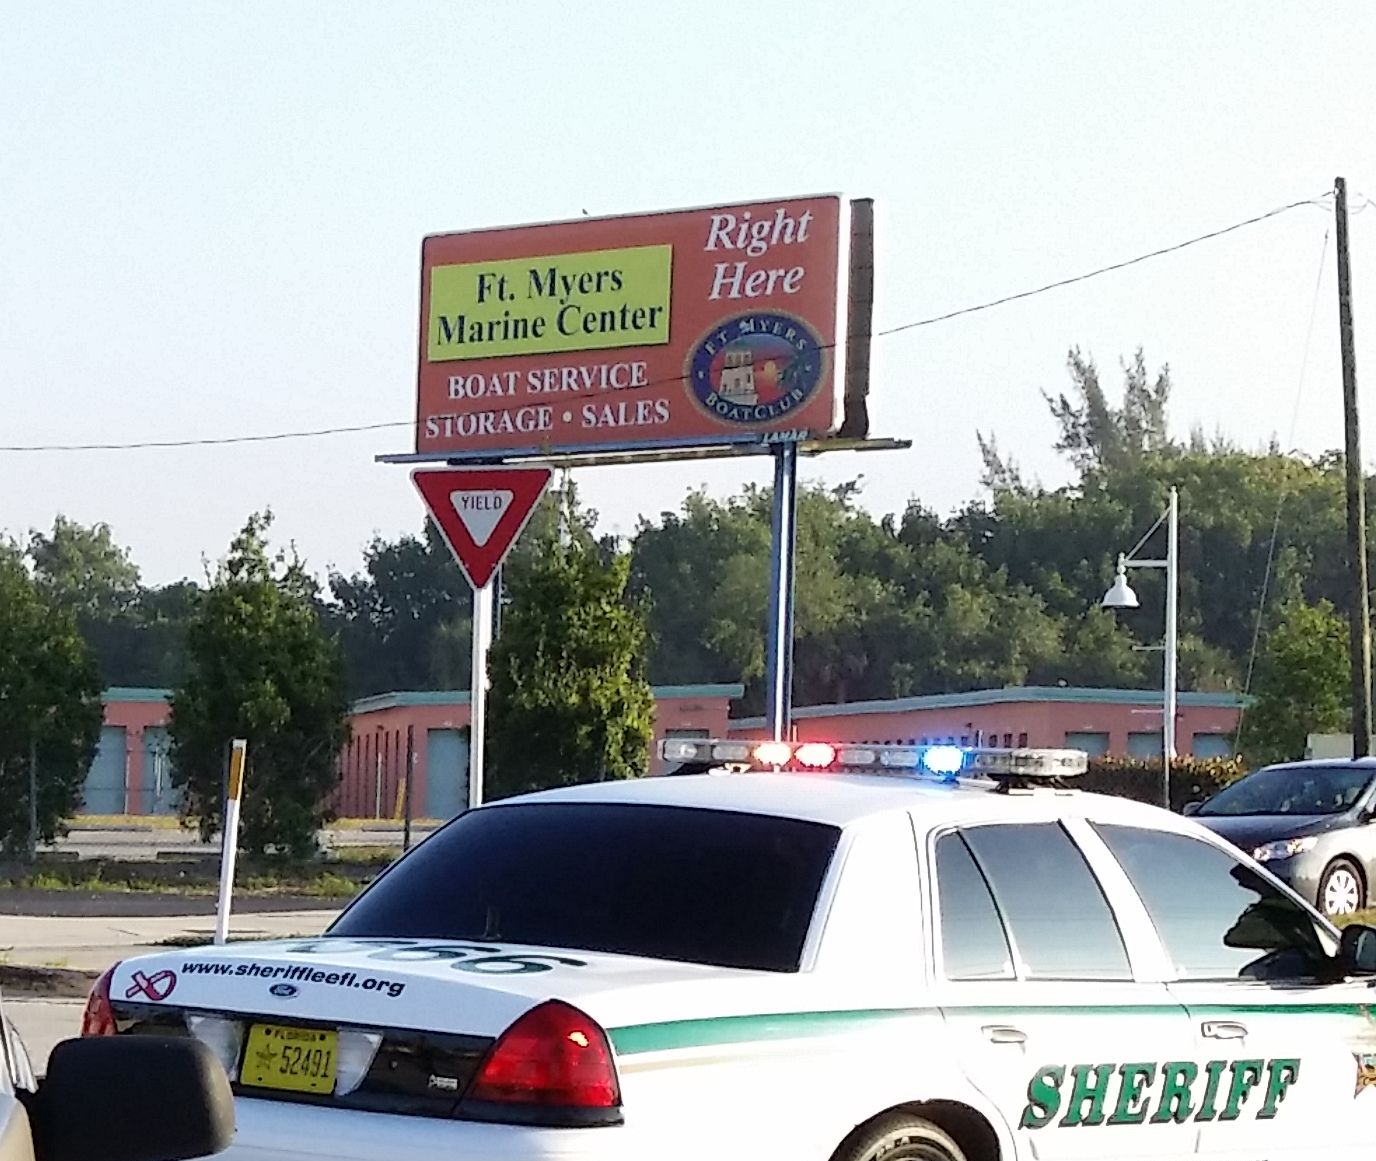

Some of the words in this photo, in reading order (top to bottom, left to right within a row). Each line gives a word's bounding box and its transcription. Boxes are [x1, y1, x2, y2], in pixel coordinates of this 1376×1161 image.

[704, 208, 814, 256] Right
[477, 273, 514, 303] Ft.
[528, 267, 623, 305] Myers
[708, 261, 805, 300] Here
[437, 310, 546, 345] Marine
[557, 303, 664, 336] Center
[704, 330, 727, 355] FT
[738, 318, 807, 350] MYERS
[448, 371, 520, 400] BOAT
[527, 361, 648, 393] SERVICE
[425, 406, 553, 438] STORAGE
[582, 399, 670, 428] SALES
[461, 496, 502, 510] YIELD
[181, 962, 406, 997] www.sheriffleefl.org
[279, 1045, 331, 1078] 52491
[1017, 1058, 1301, 1130] SHERIFF
